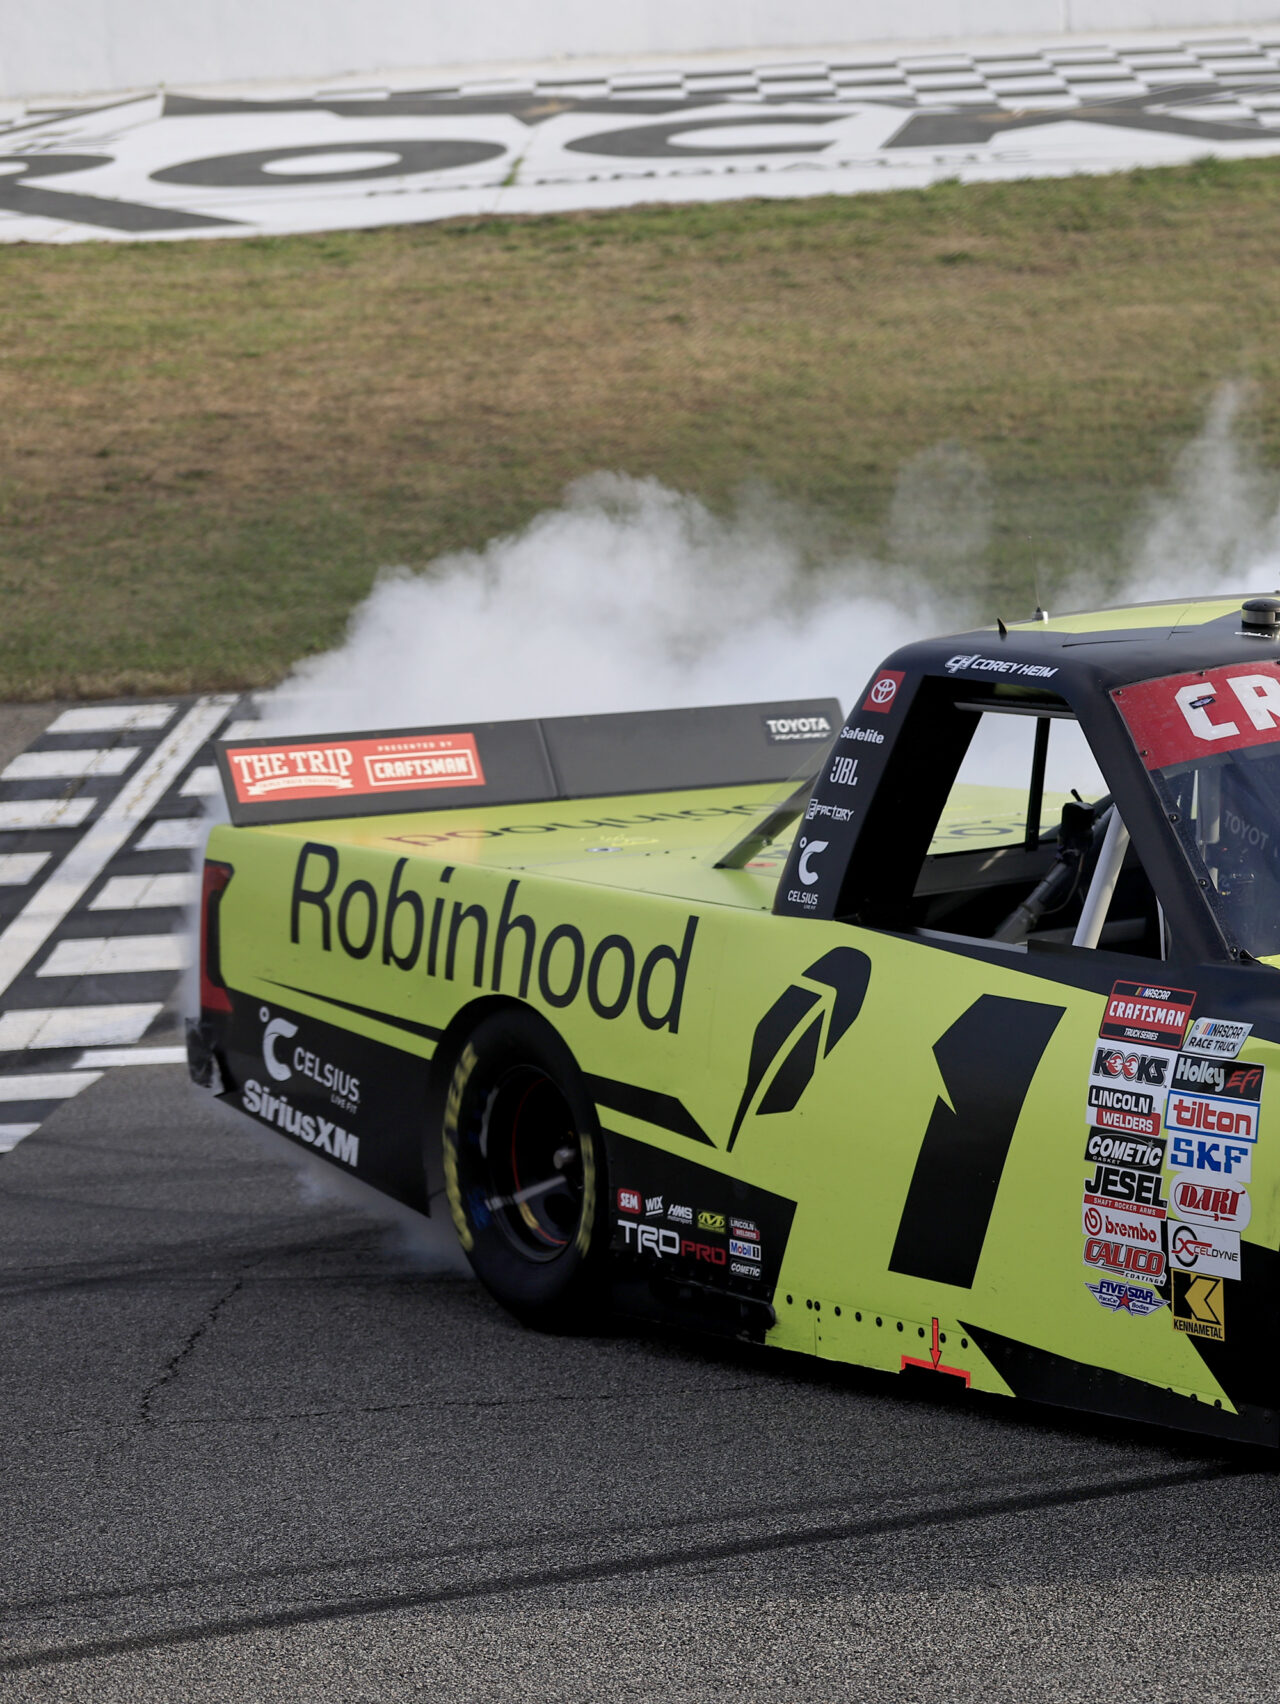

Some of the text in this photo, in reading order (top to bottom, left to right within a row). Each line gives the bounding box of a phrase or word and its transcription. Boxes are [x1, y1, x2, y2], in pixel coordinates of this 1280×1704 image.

[971, 658, 1023, 674] COREY
[1017, 664, 1059, 678] HEIM
[766, 717, 831, 733] TOYOTA
[840, 726, 885, 744] Safelite
[232, 752, 289, 784] THE
[288, 748, 353, 776] TRIP
[373, 756, 468, 779] CRAFTSMAN
[829, 756, 859, 786] JBL
[787, 889, 819, 905] CELSIUS
[290, 841, 700, 1034] Robinhood
[1142, 988, 1171, 1000] NASCAR
[1109, 1001, 1185, 1027] CRAFTSMAN
[1124, 1028, 1159, 1040] TRUCK SERIES
[1211, 1024, 1243, 1039] NASCAR
[1189, 1037, 1238, 1052] RACE TRUCK
[293, 1046, 360, 1102] CELSIUS
[1093, 1047, 1170, 1086] KOOKS
[1175, 1057, 1262, 1094] Holley EFI
[1091, 1089, 1151, 1114] LINCOLN
[242, 1079, 360, 1167] SiriusXM
[1102, 1111, 1154, 1132] WELDERS
[1173, 1099, 1252, 1135] tilton
[888, 993, 1067, 1290] 1
[1088, 1136, 1163, 1167] COMETIC
[1092, 1156, 1121, 1165] GASKET
[1171, 1137, 1248, 1174] SKF
[1084, 1165, 1167, 1208] JESEL
[620, 1192, 639, 1210] SEM
[645, 1195, 663, 1211] WIX
[1093, 1197, 1156, 1216] SHAFT ROCKER ARMS
[1178, 1183, 1246, 1216] DART
[668, 1204, 693, 1219] HMS
[731, 1219, 754, 1231] LINCOLN
[1105, 1215, 1157, 1243] brembo
[617, 1219, 727, 1265] TRD PRO
[731, 1241, 751, 1256] Mobil
[1084, 1238, 1166, 1277] CALICO
[731, 1262, 760, 1277] COMETIC
[1125, 1273, 1164, 1285] COATINGS
[1100, 1281, 1154, 1304] FIVE STAR
[1173, 1318, 1223, 1339] KENNAMETAL
